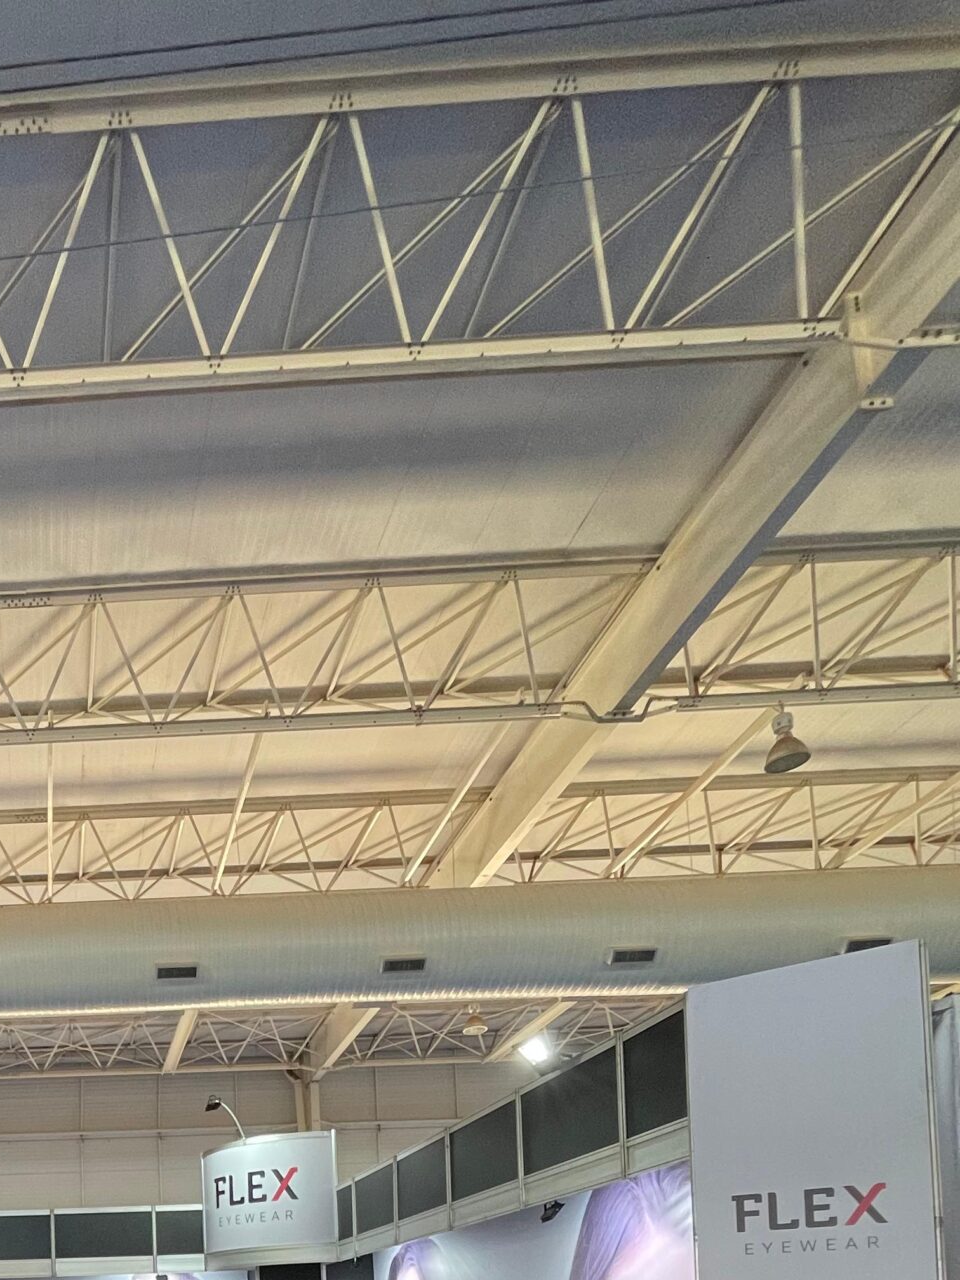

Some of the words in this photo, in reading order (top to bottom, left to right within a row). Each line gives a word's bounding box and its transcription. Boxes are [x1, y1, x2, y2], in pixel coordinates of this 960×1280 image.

[214, 1167, 299, 1209] FLEX
[218, 1209, 294, 1227] EYEWEAR
[731, 1182, 888, 1232] FLEX
[744, 1235, 880, 1255] EYEWEAR
